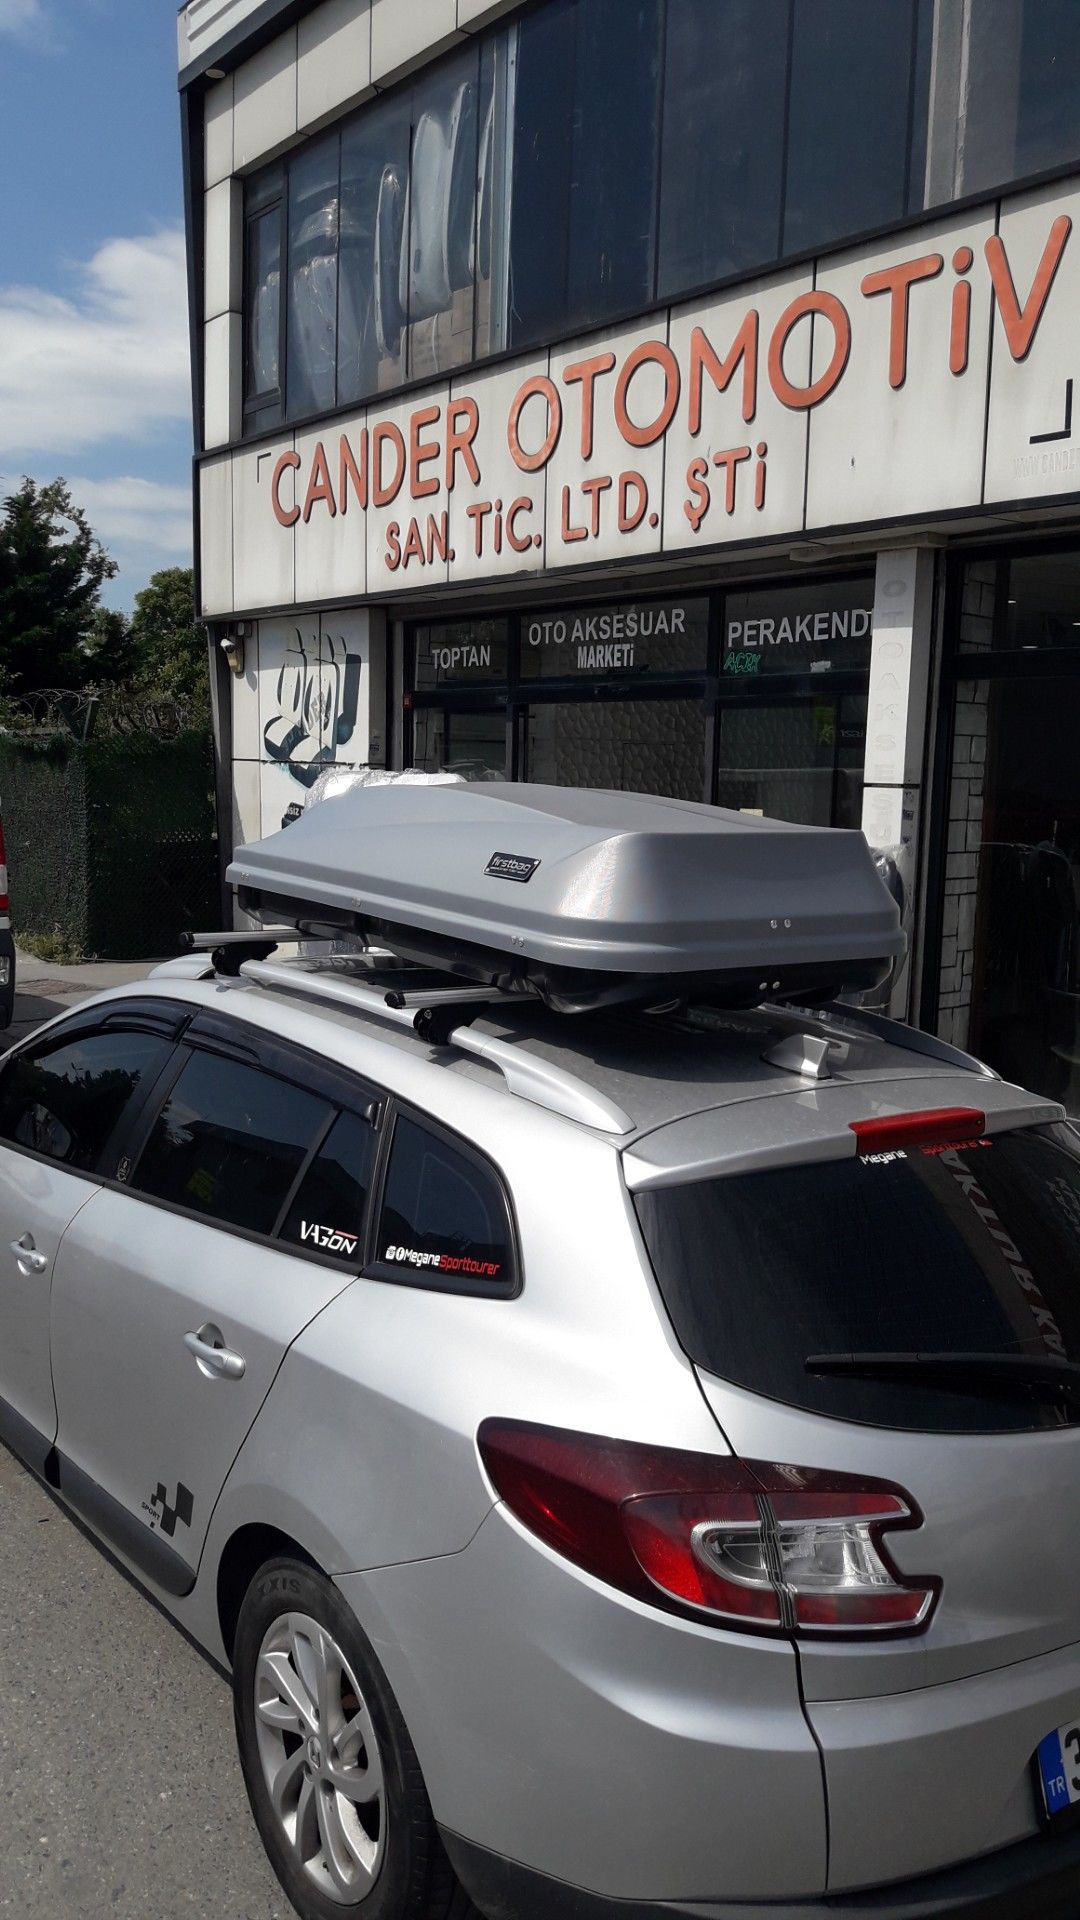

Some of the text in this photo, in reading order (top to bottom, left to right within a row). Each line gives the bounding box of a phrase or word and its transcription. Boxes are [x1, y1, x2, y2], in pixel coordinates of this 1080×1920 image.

[271, 396, 481, 528] CANDER
[384, 511, 456, 571] SAN.
[561, 471, 660, 543] LTD.
[529, 608, 686, 646] OTO AKSESUAR
[727, 607, 873, 648] PERAKEND
[432, 645, 491, 670] TOPTAN
[491, 856, 531, 873] firstbag
[860, 1149, 908, 1165] Megane
[1047, 1775, 1066, 1797] TR
